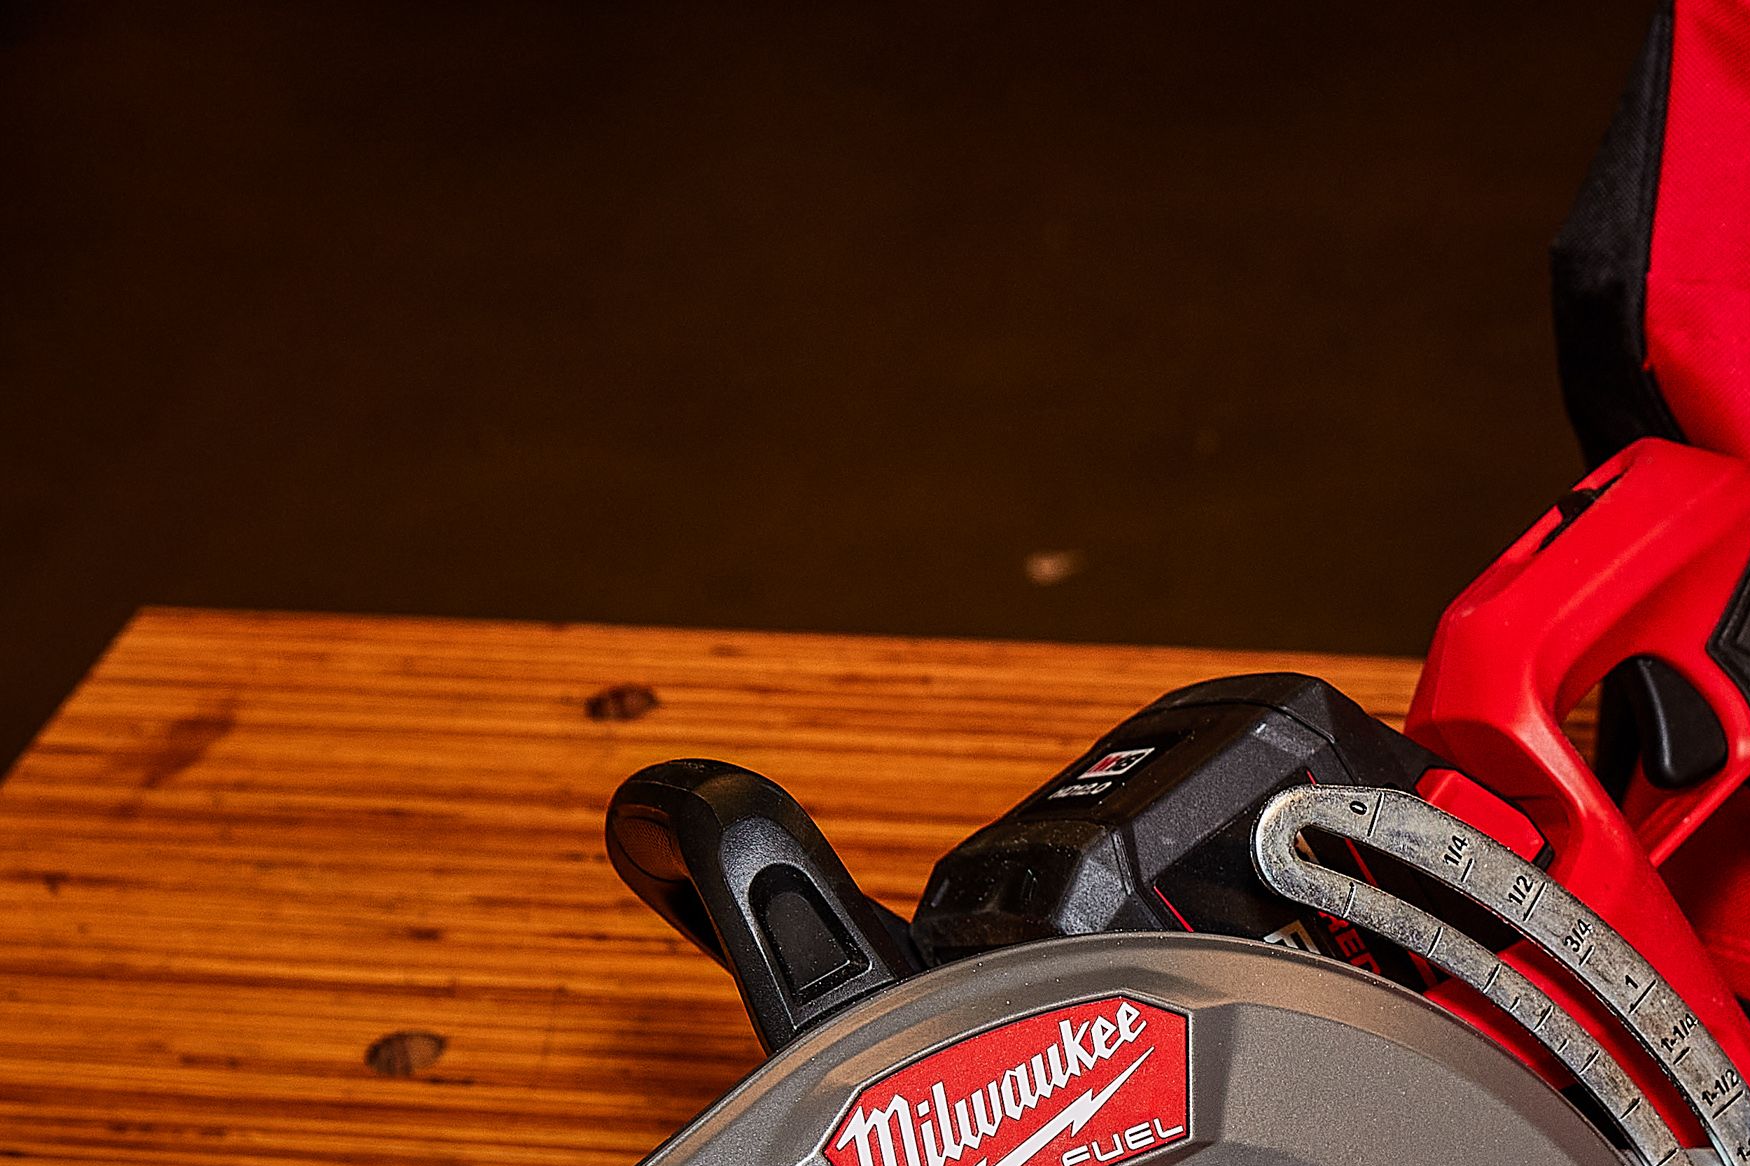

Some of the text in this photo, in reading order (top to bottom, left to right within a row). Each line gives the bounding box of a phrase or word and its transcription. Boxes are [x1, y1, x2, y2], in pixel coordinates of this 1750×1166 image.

[1350, 800, 1368, 816] 0
[1443, 835, 1469, 866] 1/4
[1507, 875, 1534, 906] 1/2
[1564, 919, 1592, 952] 3/4
[1625, 974, 1639, 990] 1
[1661, 1013, 1698, 1053] 1-1/4
[1701, 1069, 1742, 1107] 1-1/2
